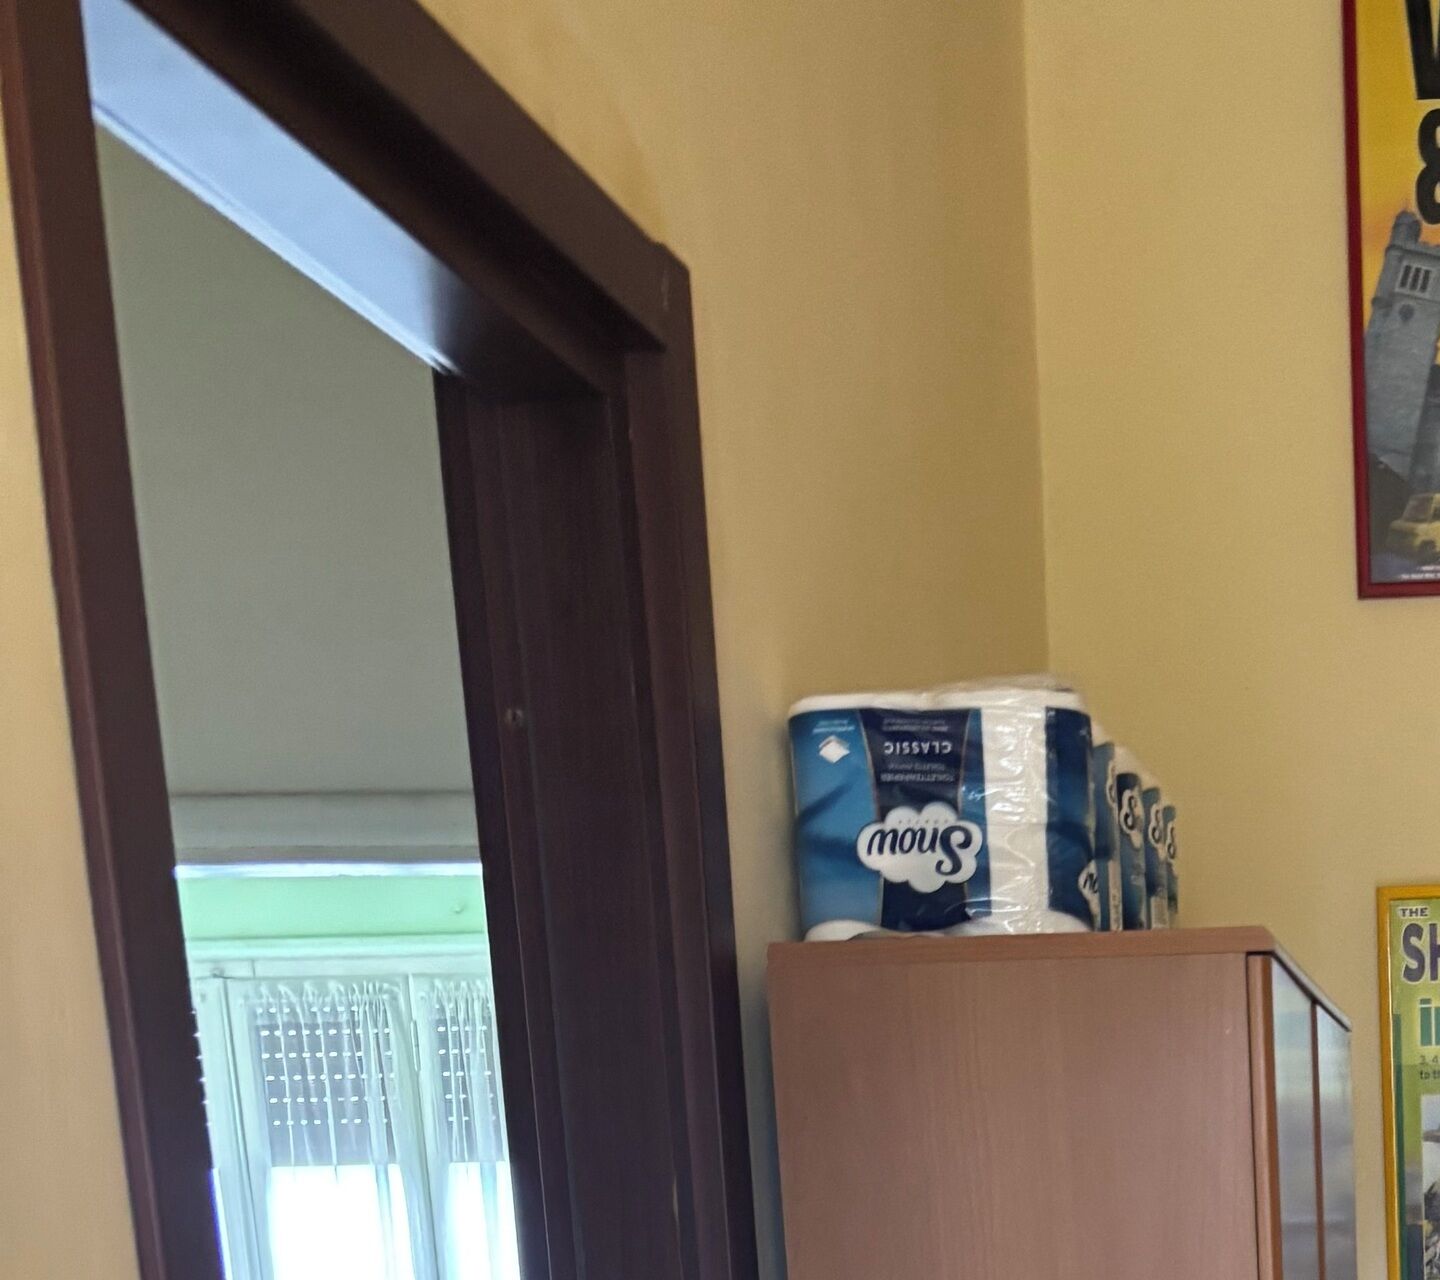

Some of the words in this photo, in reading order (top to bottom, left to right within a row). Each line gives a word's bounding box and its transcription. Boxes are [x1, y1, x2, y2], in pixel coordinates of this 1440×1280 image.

[884, 741, 952, 755] CLASSIC
[867, 825, 972, 876] Snow
[1400, 906, 1429, 918] THE
[1432, 1055, 1439, 1064] 4
[1419, 1070, 1431, 1080] to
